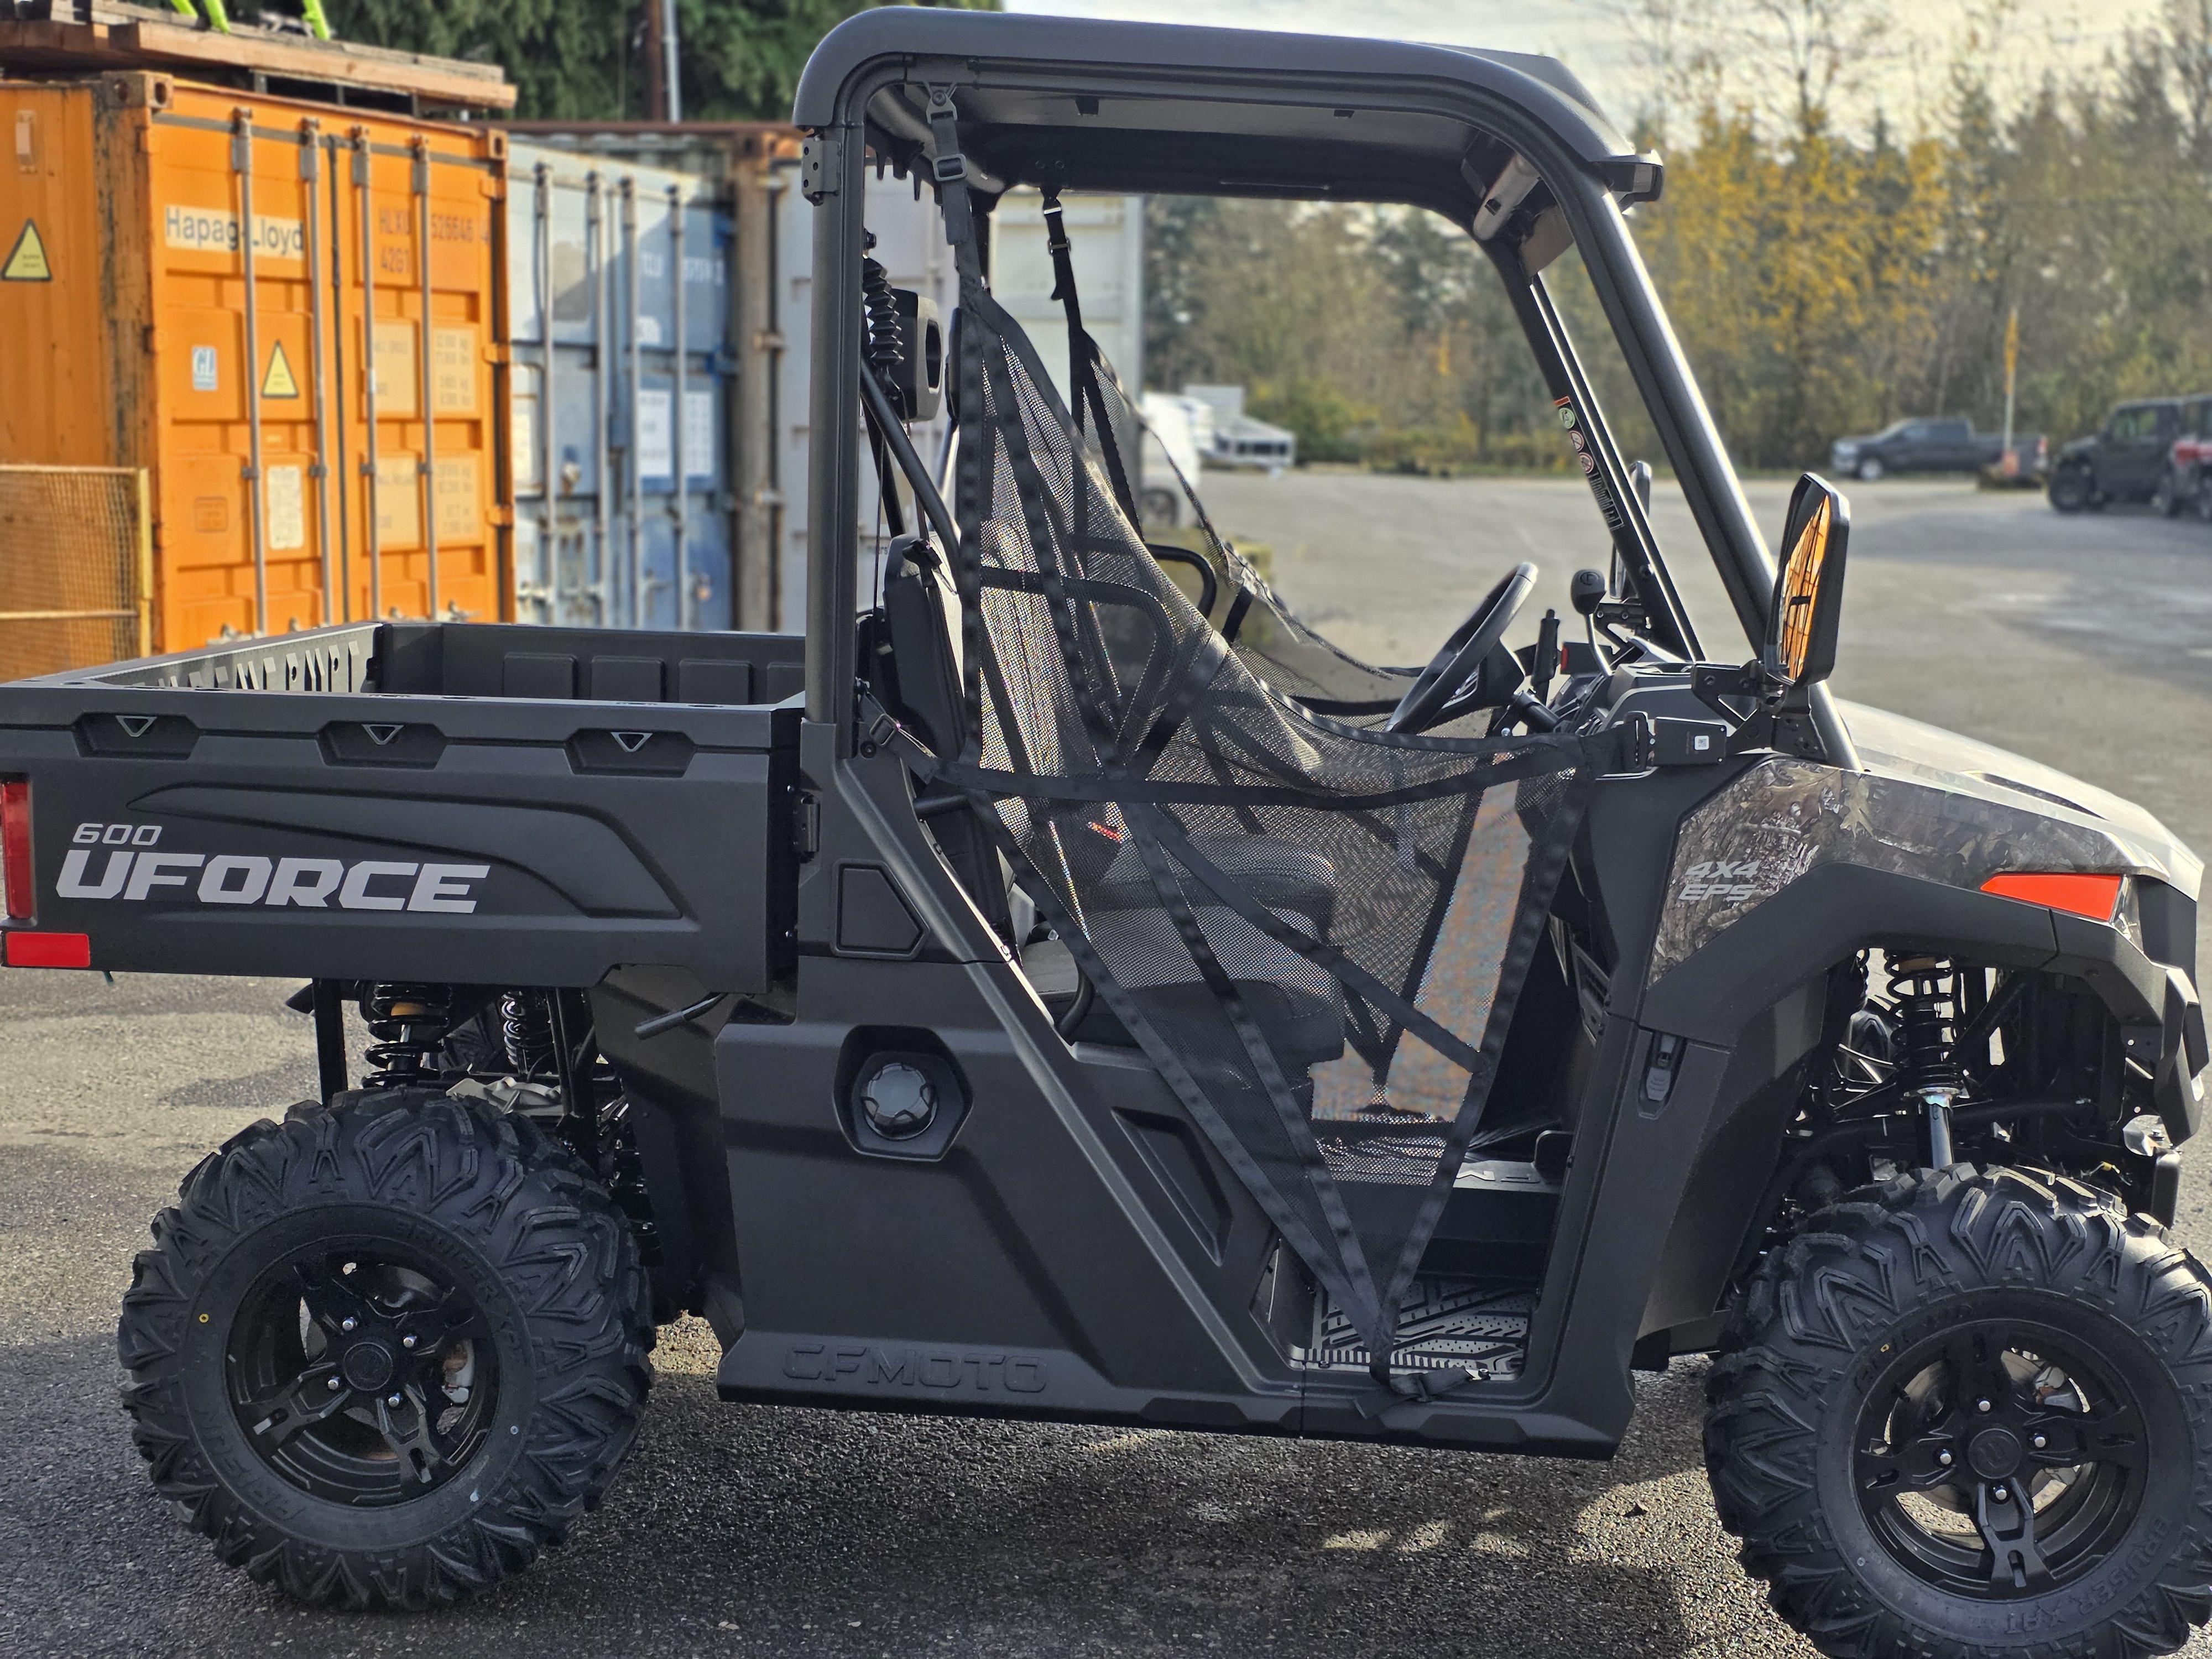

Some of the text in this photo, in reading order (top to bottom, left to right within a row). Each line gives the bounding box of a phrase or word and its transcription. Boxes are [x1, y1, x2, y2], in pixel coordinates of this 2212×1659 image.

[165, 206, 304, 255] Hapag-loyd
[73, 823, 162, 846] 600
[56, 849, 490, 913] UFORCE
[1678, 884, 1757, 901] EPS
[1685, 860, 1761, 878] 4X4
[783, 1343, 1046, 1393] CFMOTO
[2069, 1516, 2169, 1617] BRUISER
